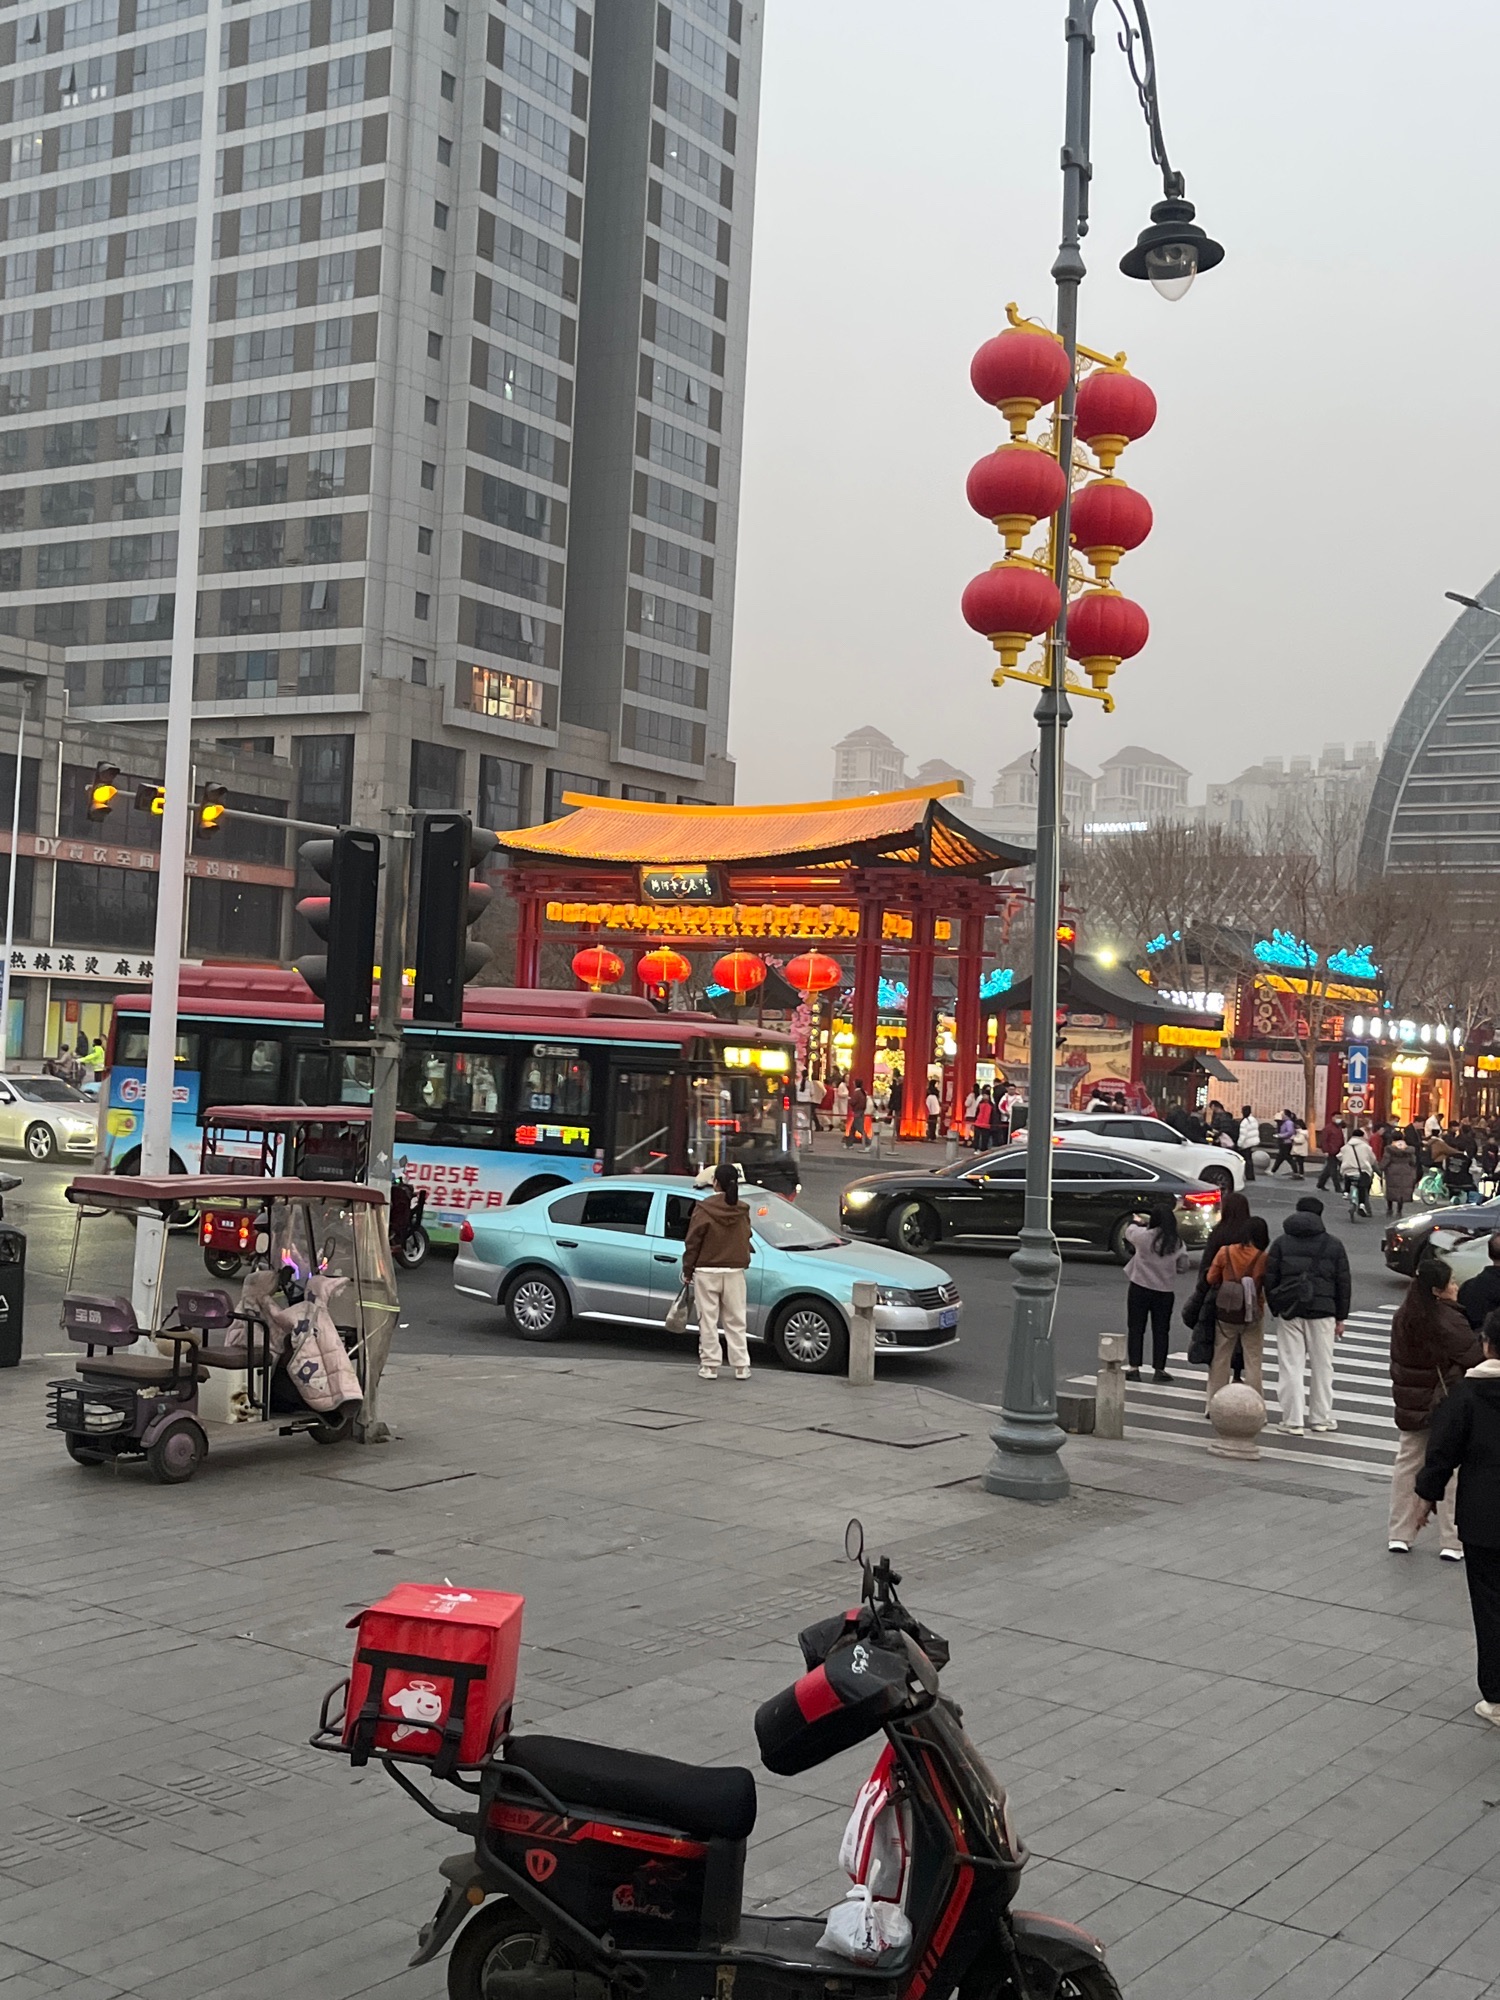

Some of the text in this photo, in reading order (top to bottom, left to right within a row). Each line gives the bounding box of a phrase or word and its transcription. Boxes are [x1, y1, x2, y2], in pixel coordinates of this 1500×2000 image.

[34, 837, 61, 856] DY
[69, 844, 240, 879] 餐饮空间案设计
[10, 951, 100, 975] 热辣滚烫
[530, 1094, 551, 1110] 619
[1350, 1100, 1363, 1108] 20
[404, 1162, 480, 1187] 2025年
